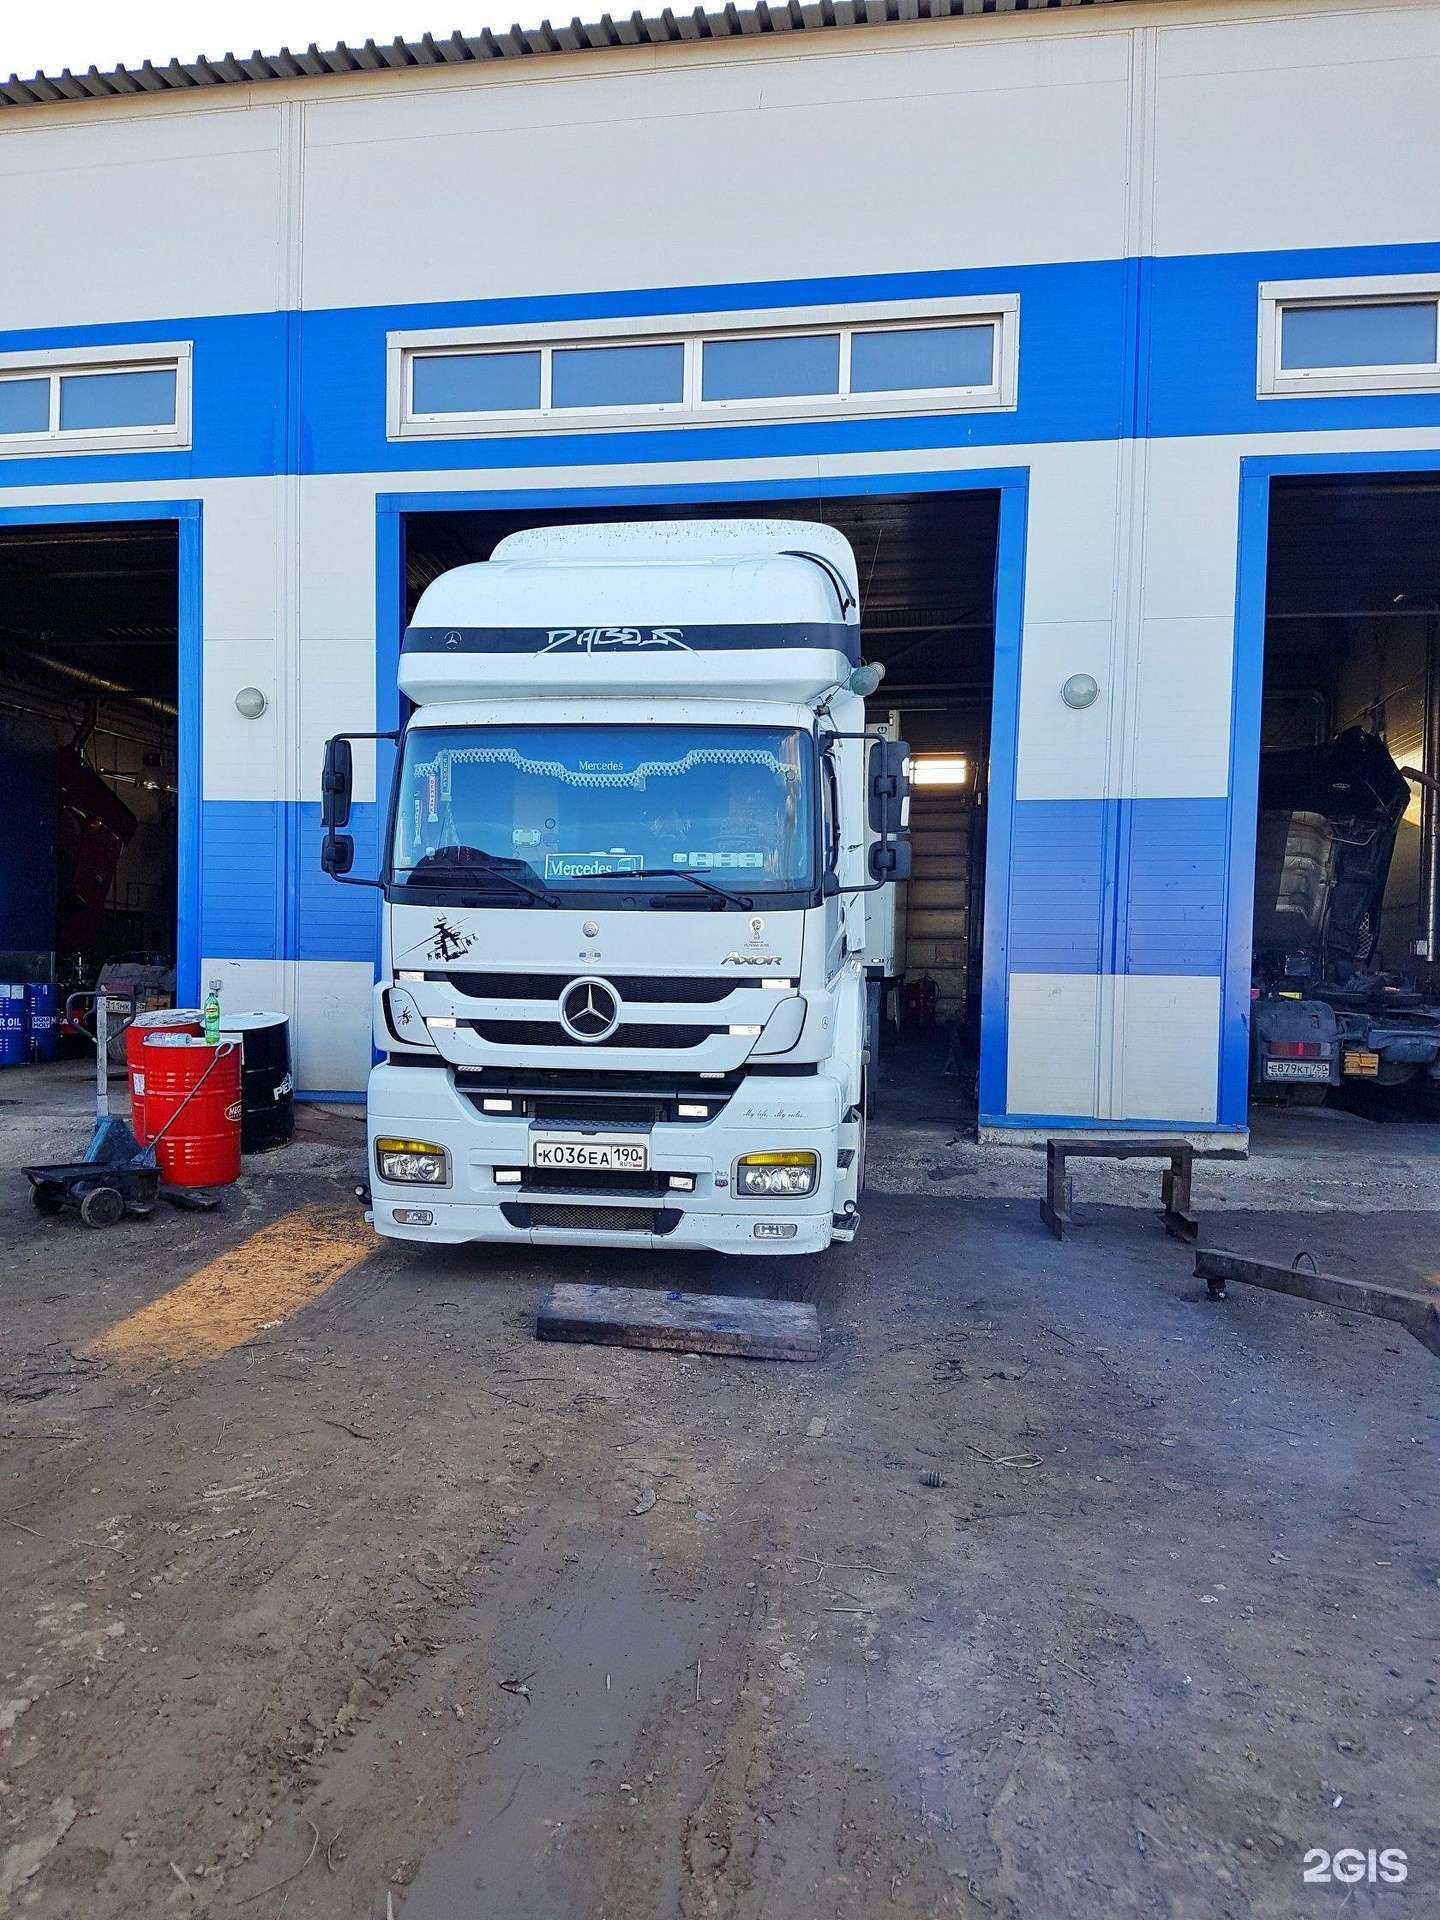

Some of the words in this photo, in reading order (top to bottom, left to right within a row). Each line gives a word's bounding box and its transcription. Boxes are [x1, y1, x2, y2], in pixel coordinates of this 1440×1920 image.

[579, 760, 624, 771] Mercedes
[548, 860, 613, 876] Mercedes
[7, 1017, 22, 1027] OIL
[613, 1148, 639, 1161] 190
